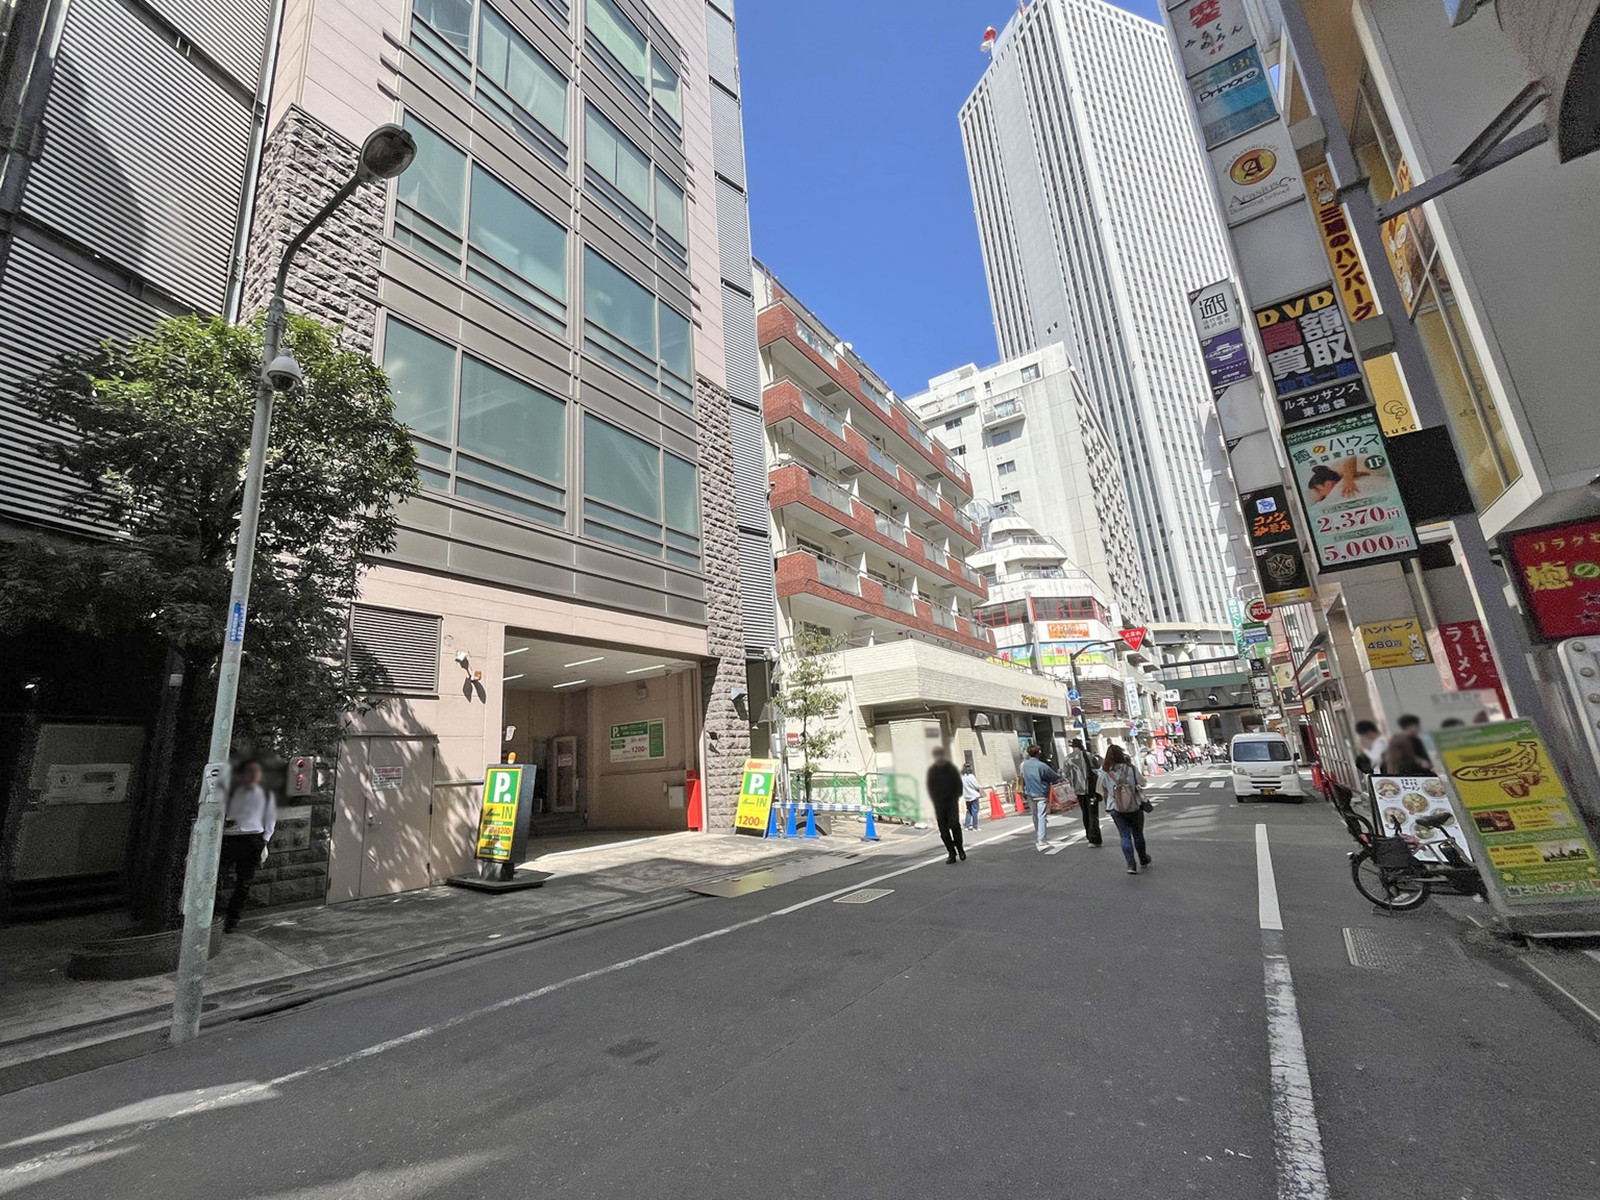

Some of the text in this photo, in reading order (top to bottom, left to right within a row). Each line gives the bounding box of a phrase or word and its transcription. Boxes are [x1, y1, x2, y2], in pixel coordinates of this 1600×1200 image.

[1256, 290, 1334, 328] DVD
[1267, 333, 1354, 380] 買取
[1284, 383, 1360, 410] ルネッサンス
[1302, 399, 1347, 417] 東池袋
[1368, 456, 1383, 469] 1F
[1363, 621, 1414, 636] ハンバーグ
[1445, 626, 1478, 687] ラーメン
[756, 797, 768, 808] IN
[501, 806, 513, 819] IN
